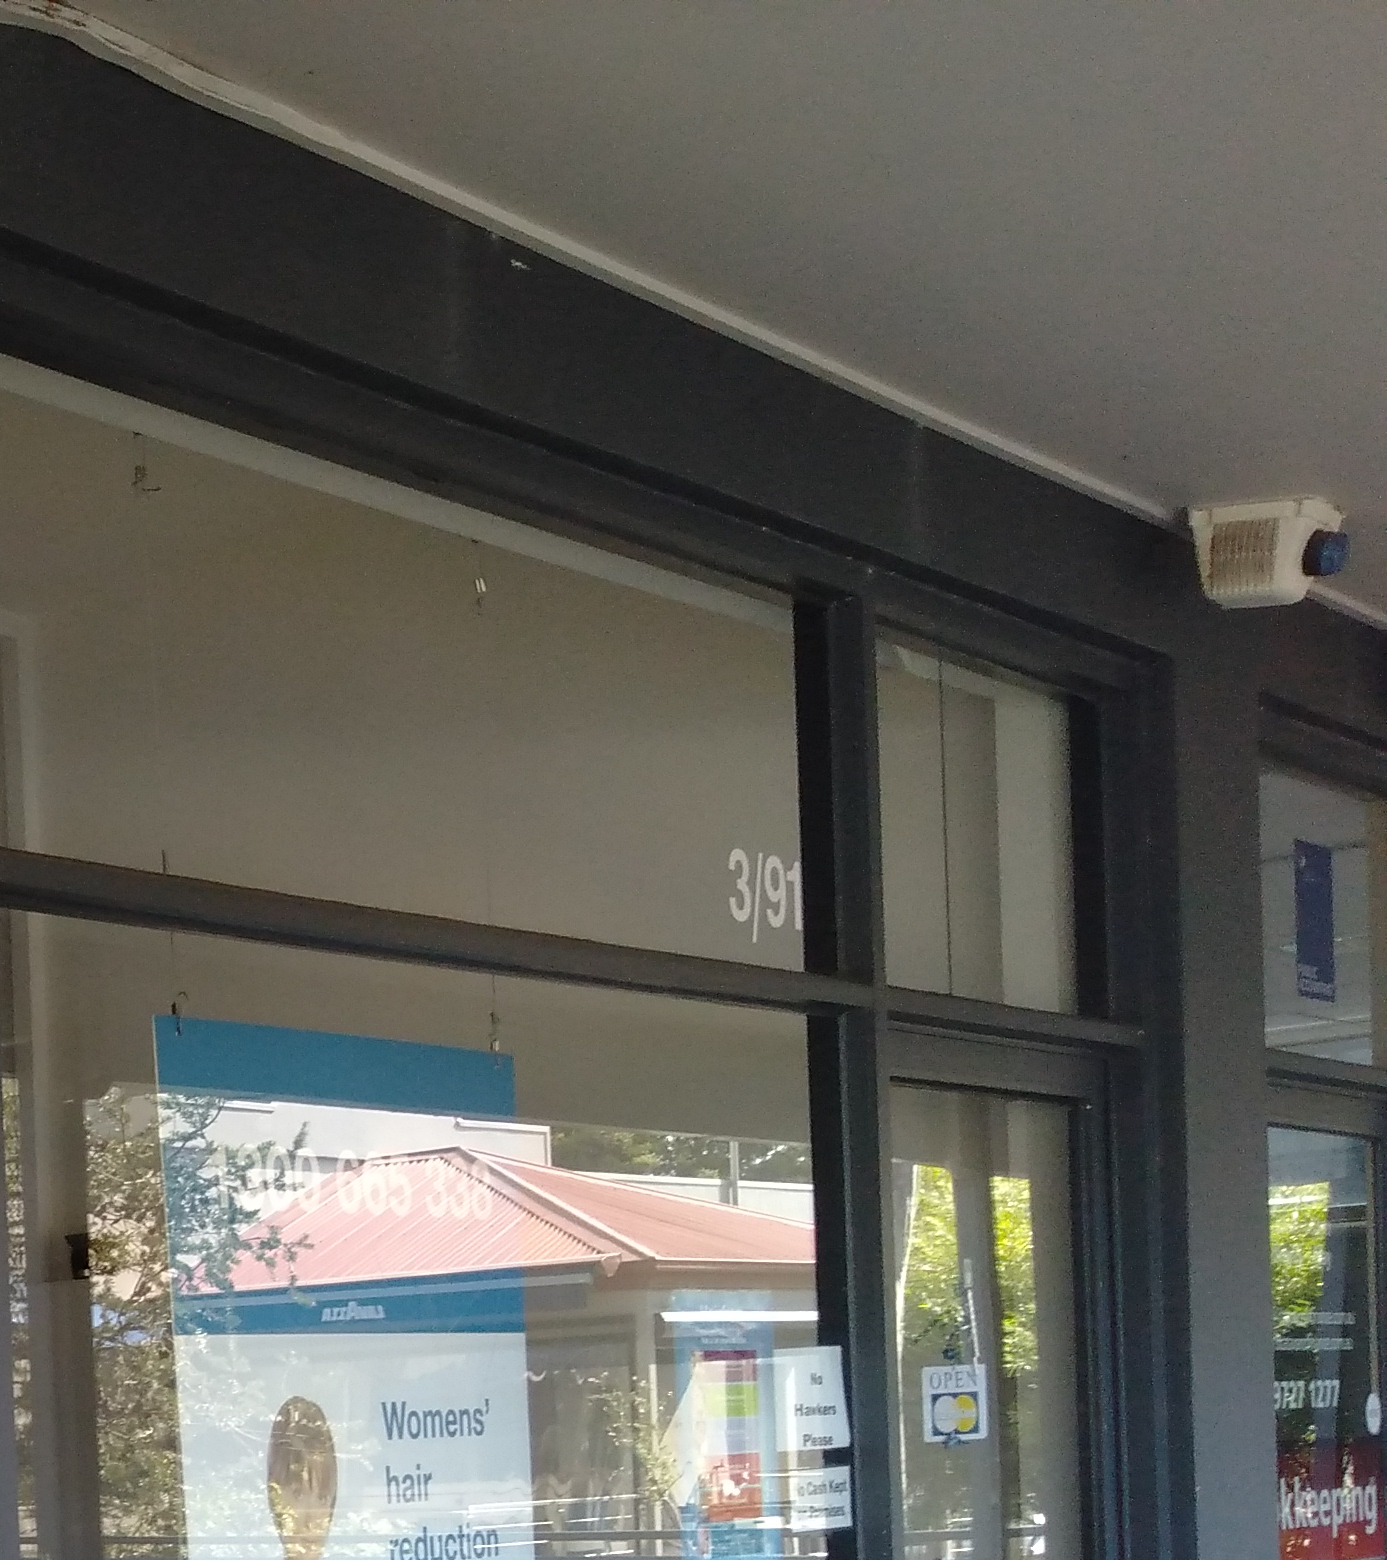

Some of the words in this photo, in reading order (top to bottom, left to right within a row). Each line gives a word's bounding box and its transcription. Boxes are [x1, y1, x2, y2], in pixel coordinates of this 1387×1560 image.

[728, 848, 803, 943] 3/91
[929, 1371, 977, 1390] OPEN
[794, 1403, 837, 1417] Hawkers
[802, 1434, 834, 1447] Please
[385, 1463, 433, 1504] hair
